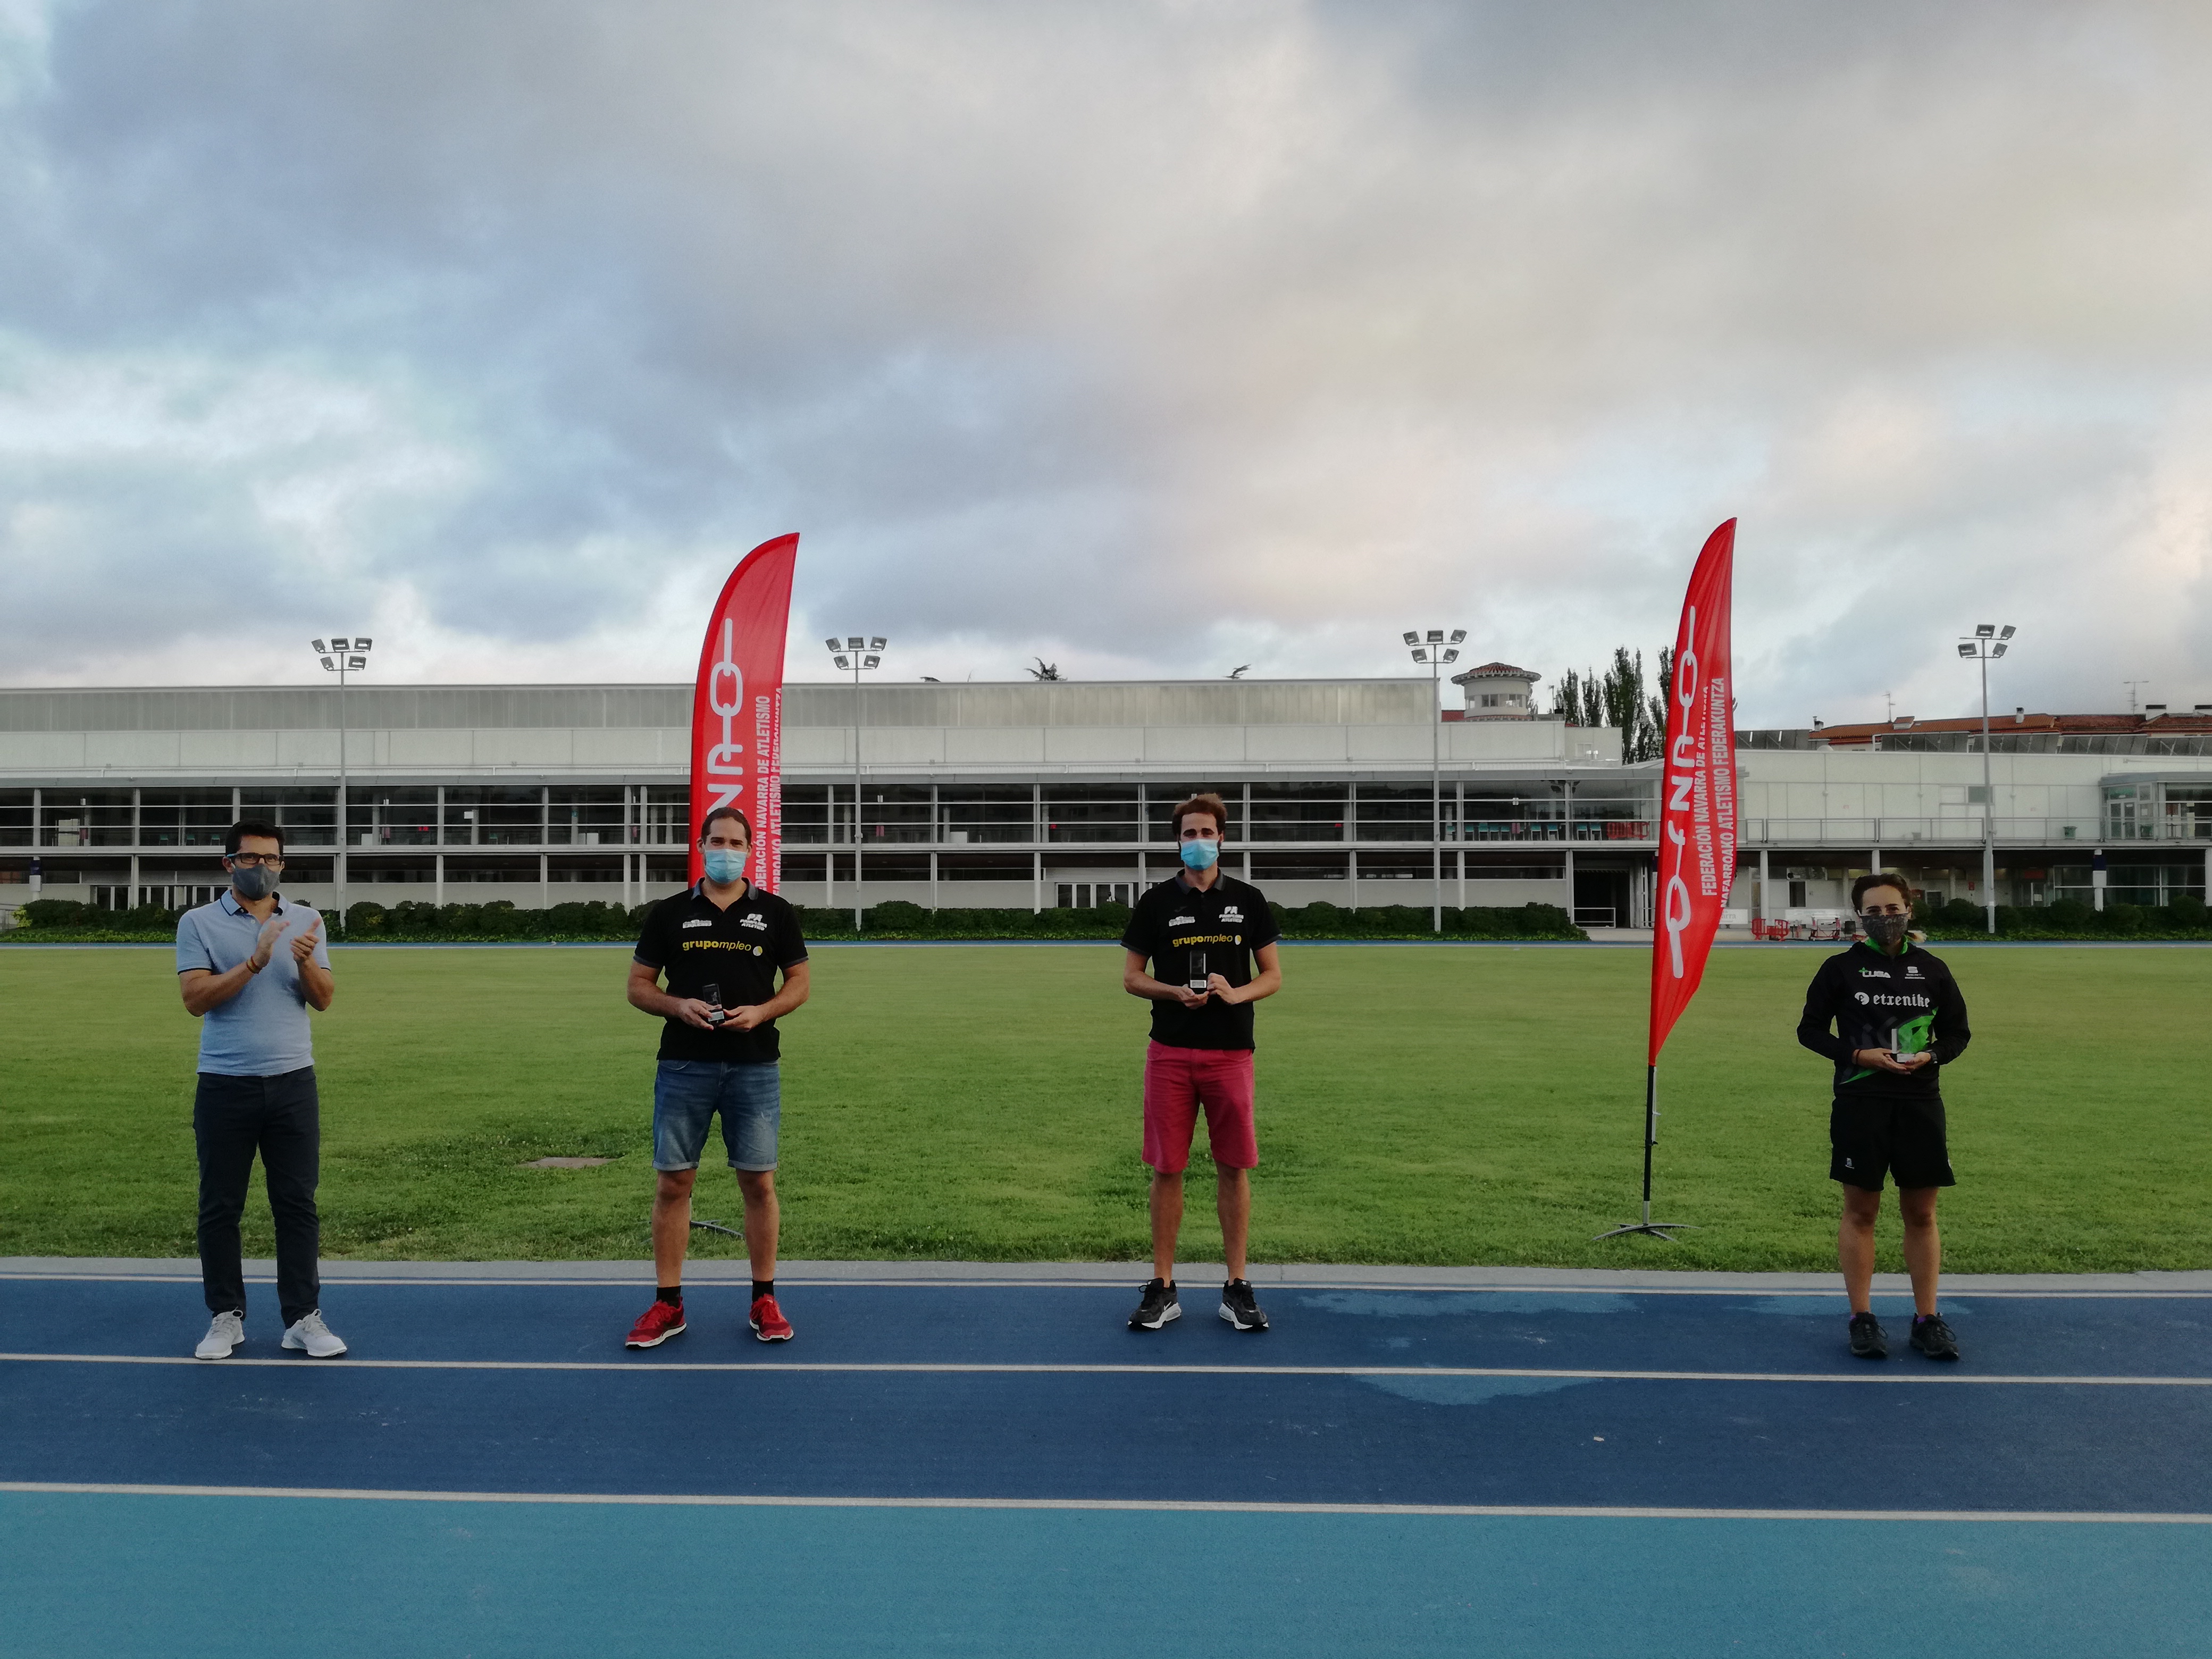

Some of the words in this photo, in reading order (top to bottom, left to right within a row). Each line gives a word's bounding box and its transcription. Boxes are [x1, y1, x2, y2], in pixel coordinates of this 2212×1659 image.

[756, 696, 770, 757] ATLETISMO
[1711, 677, 1729, 765] FEDERAKUNTZA
[757, 759, 769, 774] DE
[1696, 751, 1706, 767] DE
[757, 777, 769, 828] NAVARRA
[769, 775, 782, 835] ATLETISMO
[1694, 770, 1710, 823] NAVARRA
[1713, 768, 1734, 830] ATLETISMO
[1692, 825, 1717, 896] FEDERACIÓN
[1720, 832, 1735, 908] NAFARROAKO
